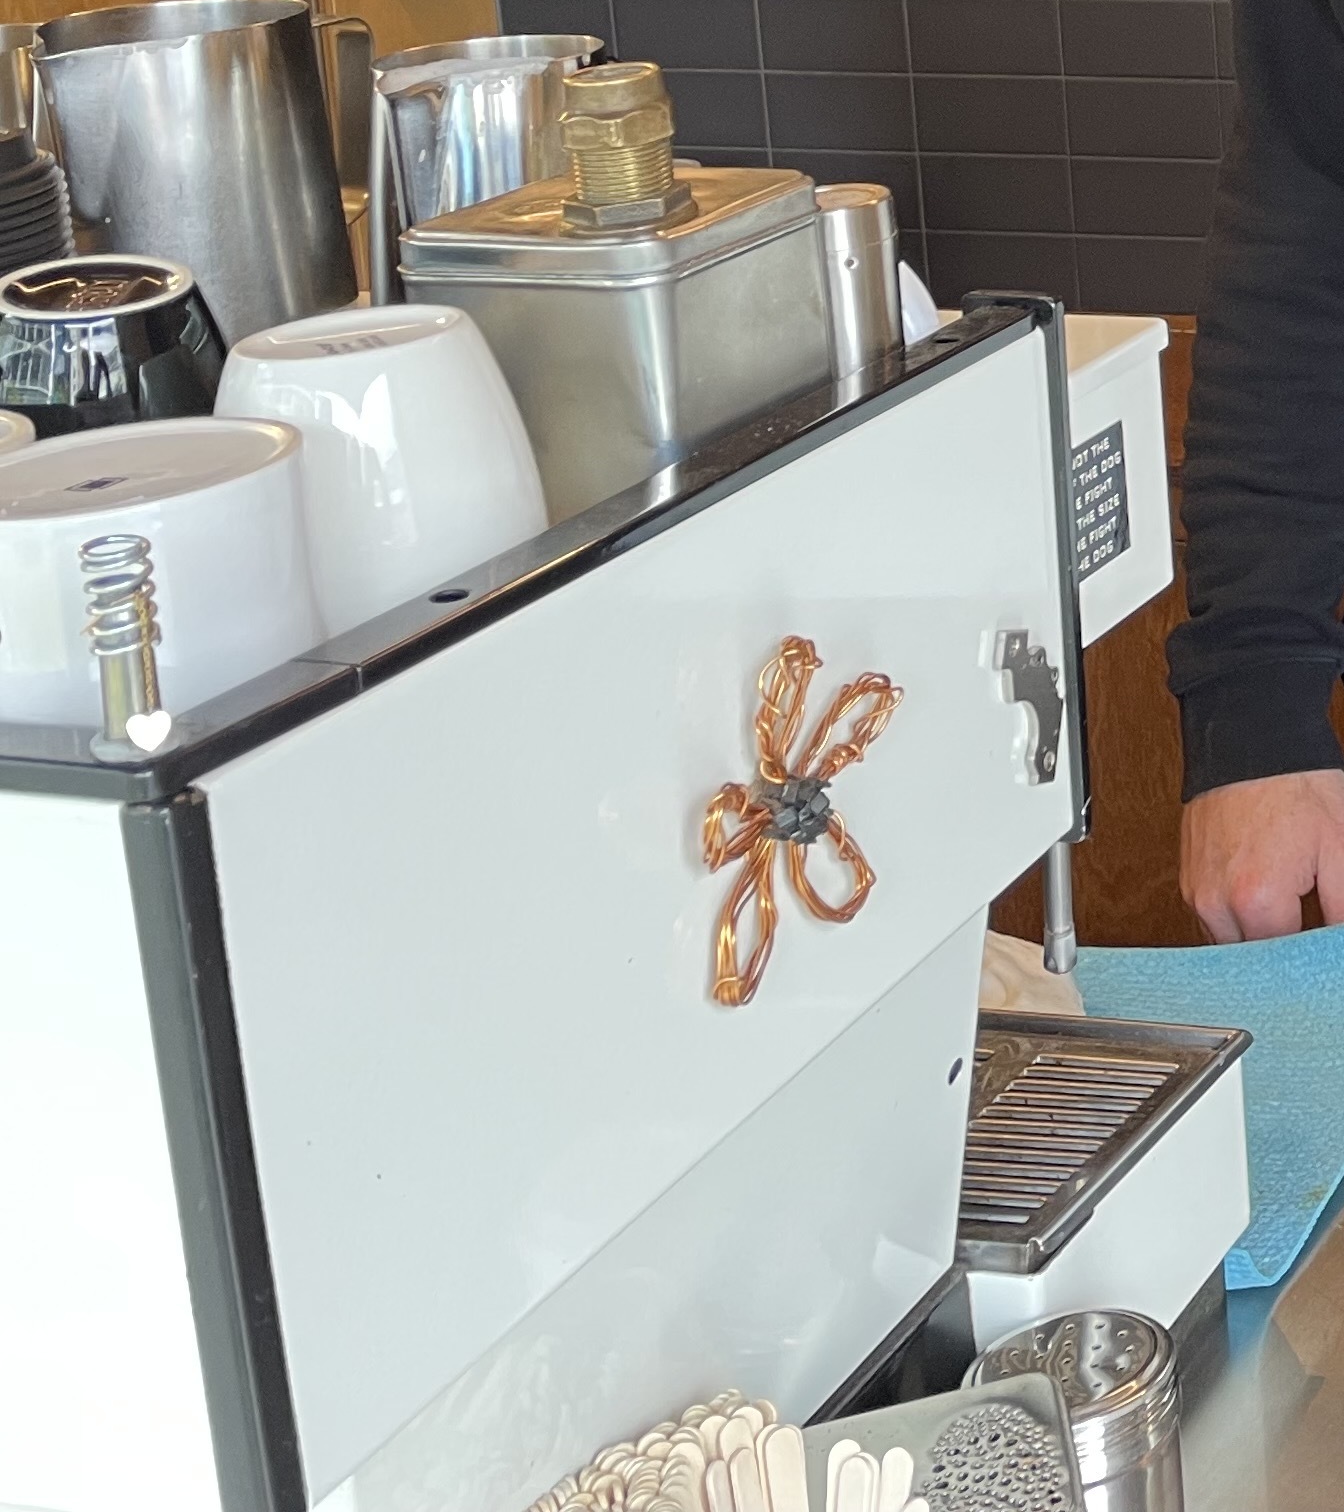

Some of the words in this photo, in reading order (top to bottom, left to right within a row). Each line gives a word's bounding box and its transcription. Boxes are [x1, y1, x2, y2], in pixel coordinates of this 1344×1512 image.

[1089, 436, 1111, 459] THE
[1078, 464, 1099, 487] THE
[1100, 450, 1122, 474] DOG
[1084, 476, 1114, 502] FIGHT
[1076, 509, 1096, 531] THE
[1097, 492, 1121, 518] SIZE
[1088, 515, 1118, 545] FIGHT
[1092, 539, 1115, 564] DOG
